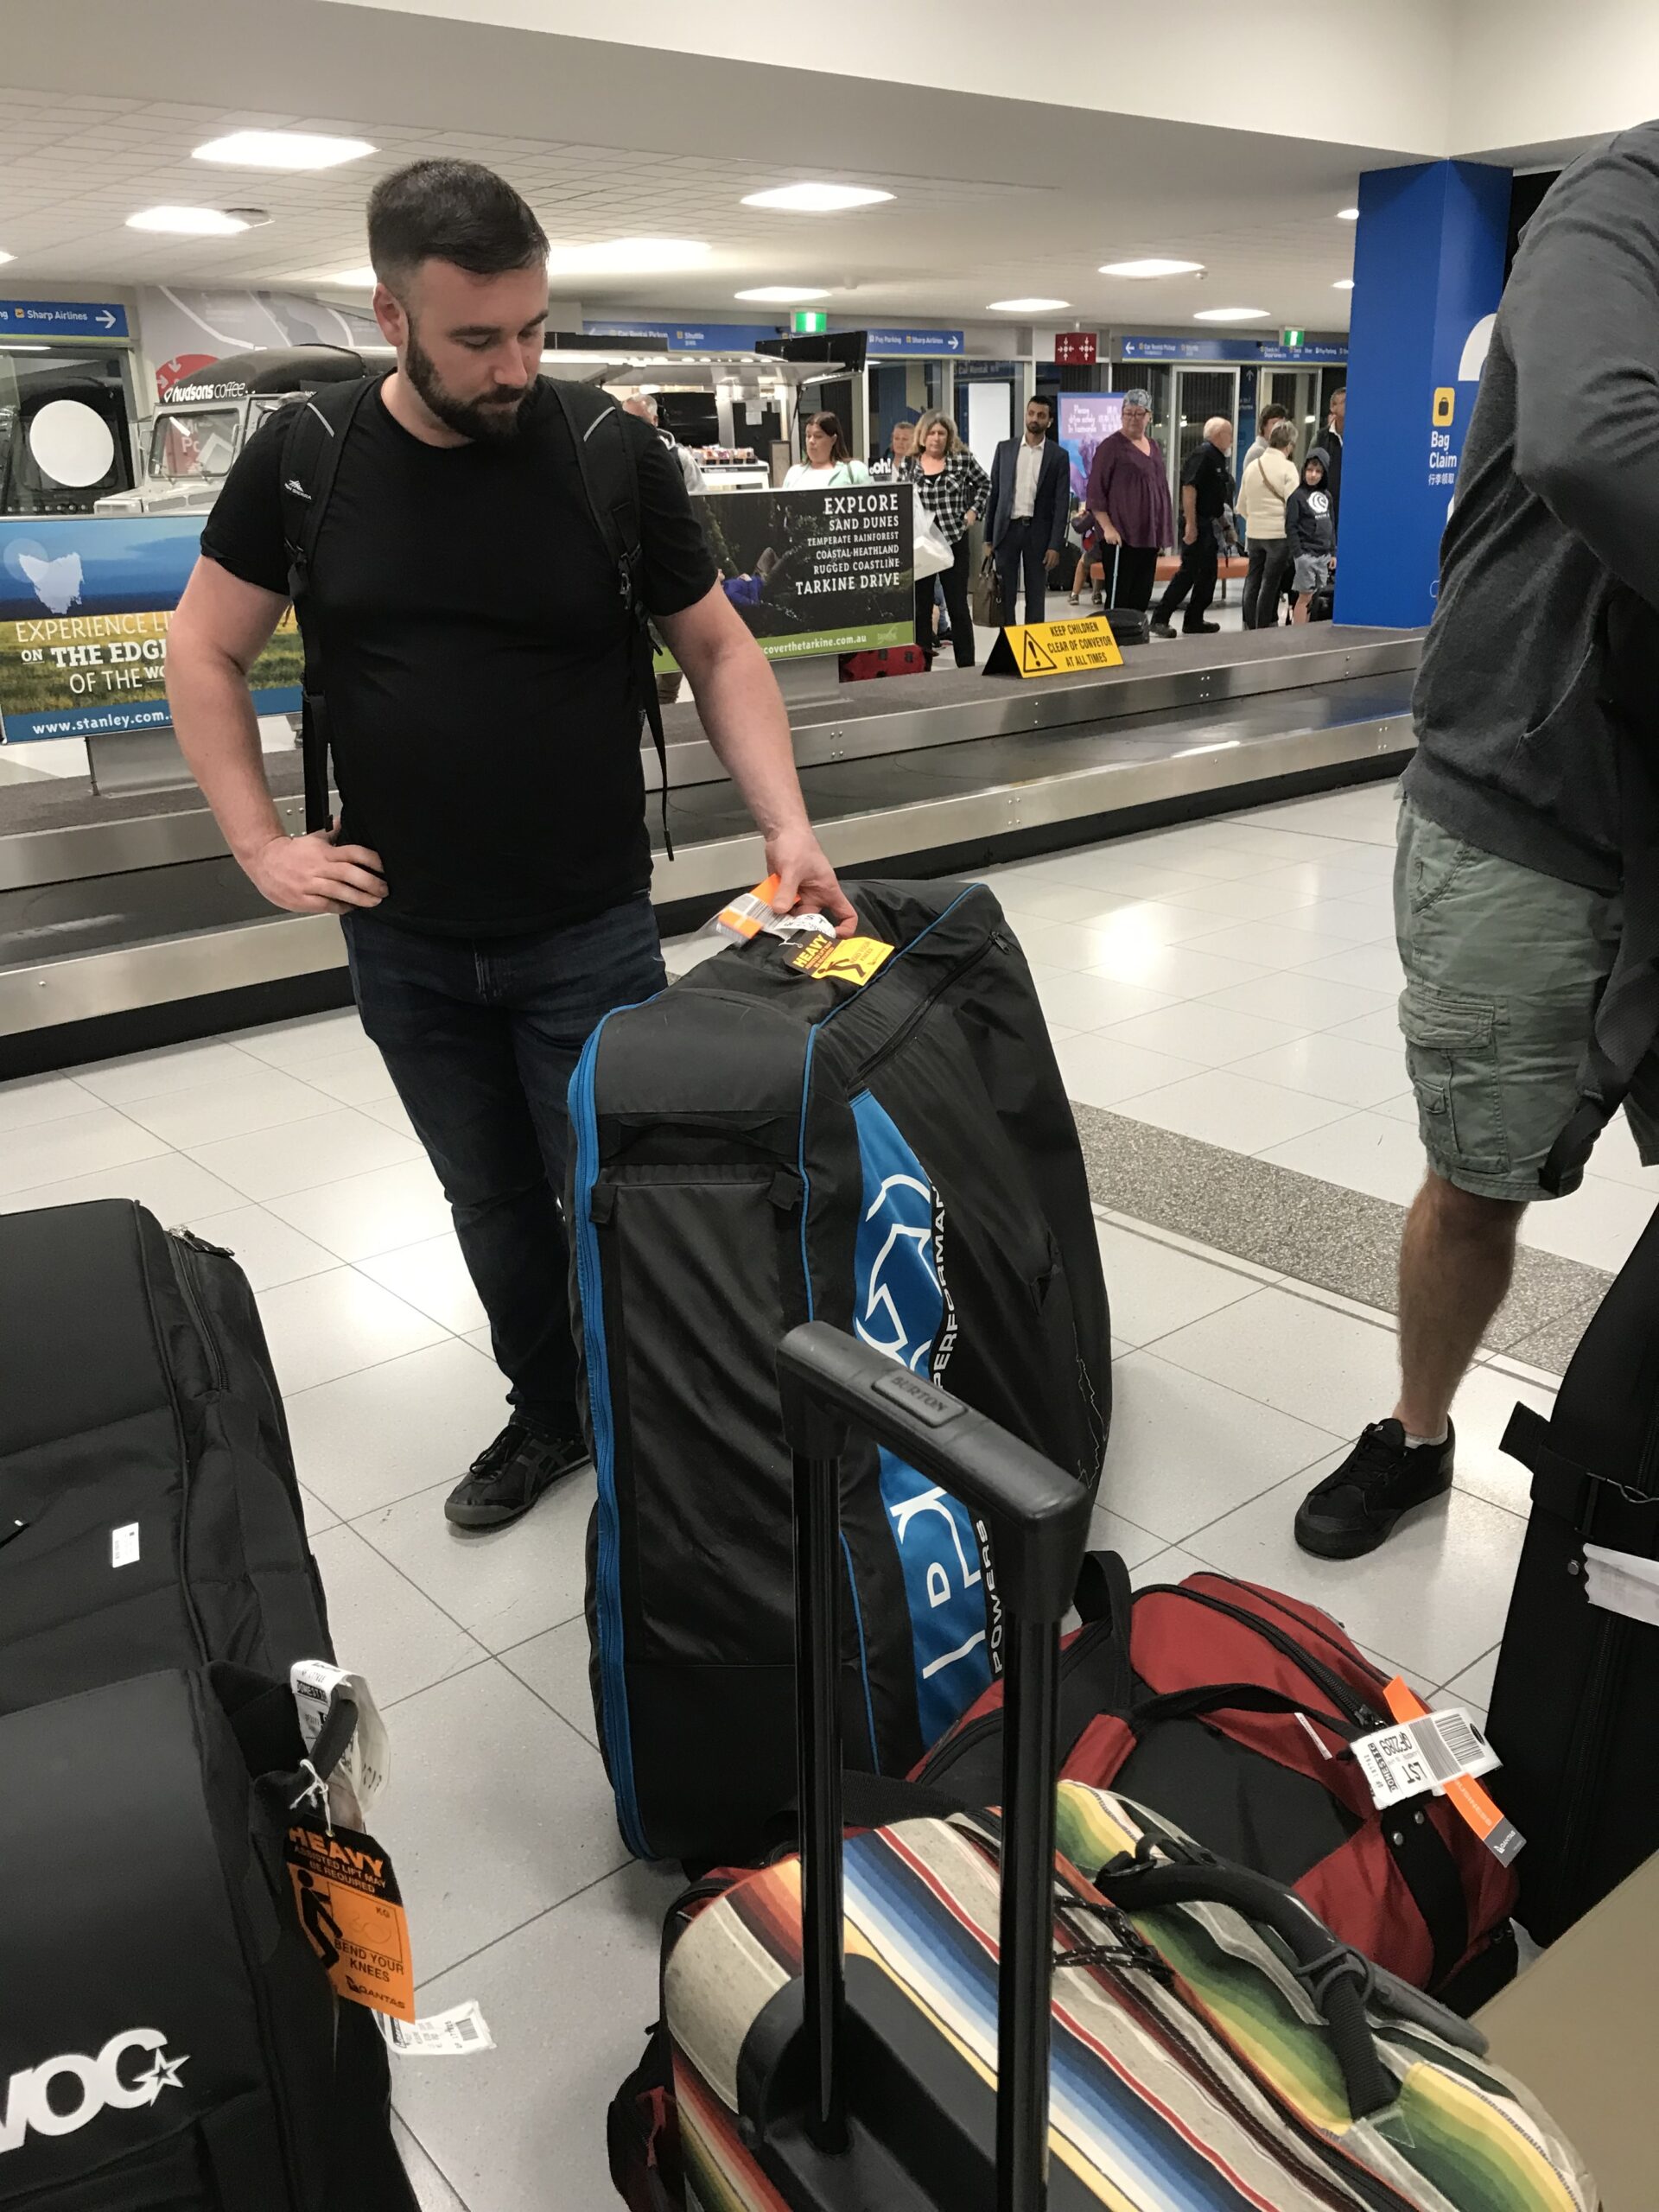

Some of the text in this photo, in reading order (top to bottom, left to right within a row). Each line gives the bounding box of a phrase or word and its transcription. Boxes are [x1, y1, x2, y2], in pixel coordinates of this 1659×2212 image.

[28, 309, 53, 321] Sharp
[54, 311, 88, 321] Airlines
[874, 335, 884, 344] Pay
[884, 335, 902, 345] Parking
[912, 336, 925, 345] Sharp
[173, 381, 246, 403] hudsons coffee
[1431, 431, 1450, 451] Bag
[1429, 452, 1457, 468] Claim
[823, 493, 899, 515] EXPLORE
[830, 515, 899, 531] SAND DUNES
[807, 531, 899, 547] TEMPERATE RAINFOREST
[816, 544, 899, 560] COASTAL HEATHLAND
[813, 557, 899, 575] RUGGED COASTLINE
[796, 572, 899, 595] TARKINE DRIVE
[16, 613, 148, 642] EXPERIENCE
[1050, 622, 1099, 637] KEEP CHILDREN
[1046, 636, 1113, 653] CLEAR OF CONVEYOR
[21, 649, 43, 662] ON
[50, 645, 104, 668] THE
[1065, 652, 1108, 667] AT ALL TIMES
[69, 672, 96, 694] OF
[101, 668, 143, 690] THE
[32, 711, 172, 734] www.stanley.com.
[792, 934, 829, 968] HEAVY
[891, 1376, 948, 1413] BURTON
[976, 1519, 1002, 1674] POWERS
[1368, 1743, 1398, 1792] DOMESTIC
[1402, 1762, 1428, 1783] LST
[1501, 1830, 1516, 1848] QANTAS
[289, 1827, 384, 1878] HEAVY
[294, 1846, 386, 1889] ASSISTED LIFT MAY
[309, 1859, 375, 1893] BE REQUIRED
[376, 1906, 391, 1918] KG
[334, 1938, 404, 1974] BEND YOUR
[350, 1957, 391, 1983] KNEES
[359, 1986, 406, 2009] QANTAS
